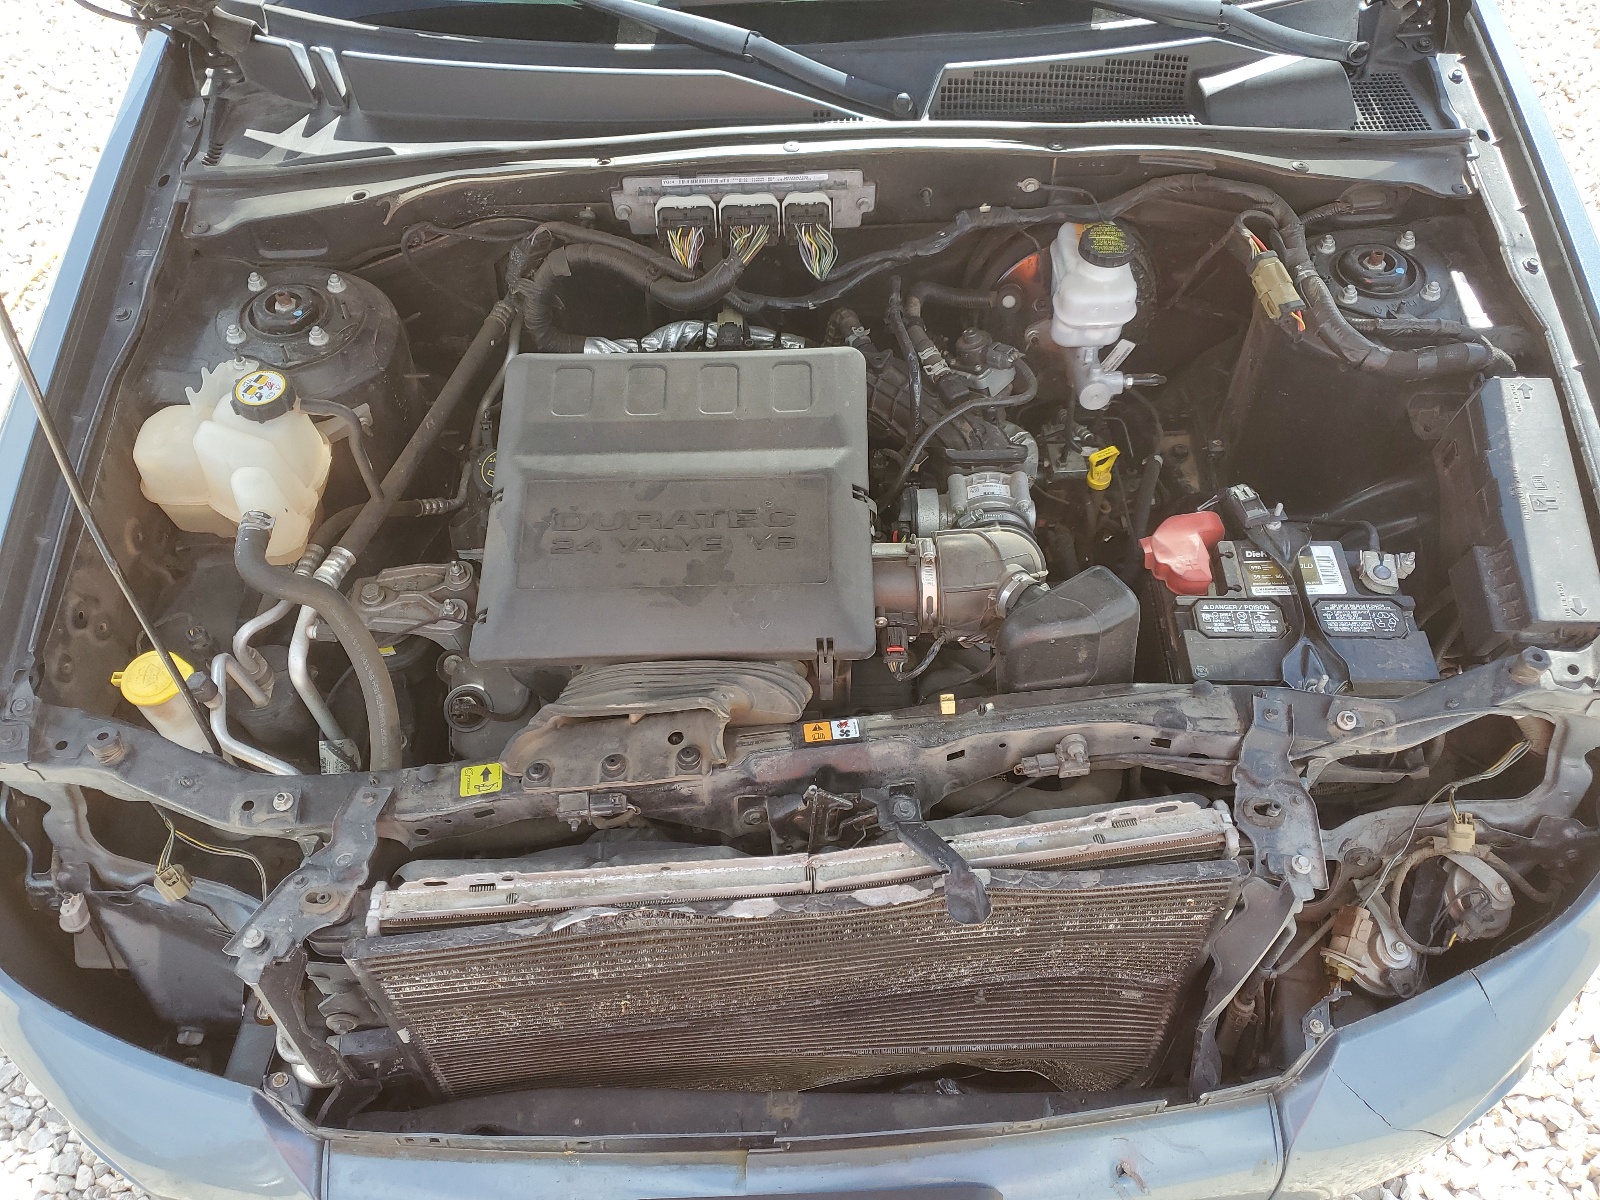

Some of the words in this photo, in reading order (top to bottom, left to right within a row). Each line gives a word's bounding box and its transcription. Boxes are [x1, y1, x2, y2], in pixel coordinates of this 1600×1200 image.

[551, 508, 797, 532] DURATEC
[550, 538, 601, 555] 24
[610, 534, 726, 553] VALVE
[747, 532, 798, 551] V6
